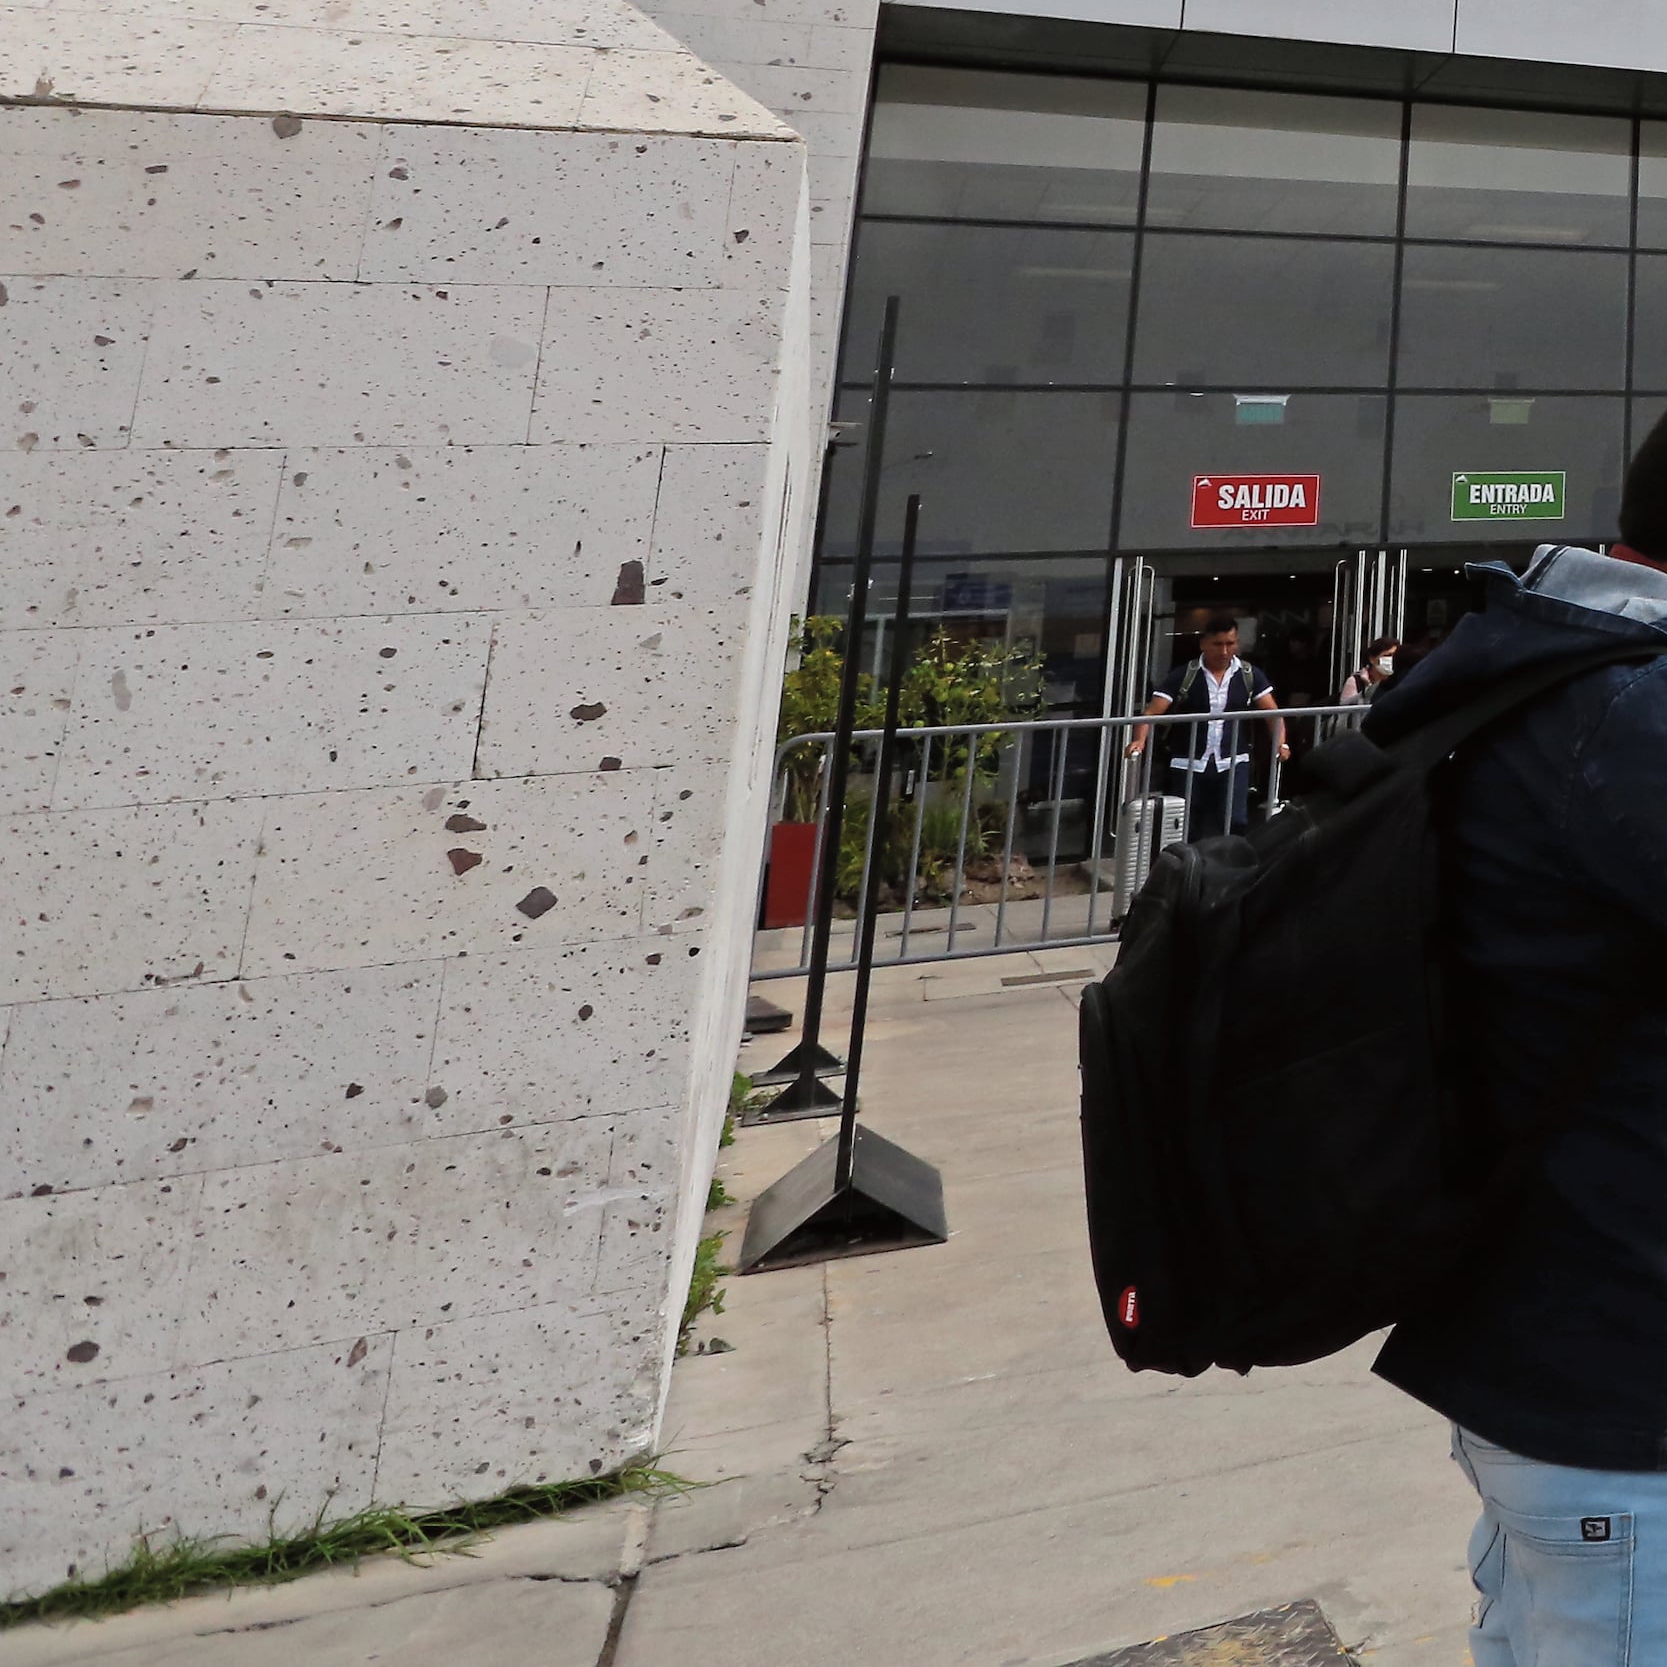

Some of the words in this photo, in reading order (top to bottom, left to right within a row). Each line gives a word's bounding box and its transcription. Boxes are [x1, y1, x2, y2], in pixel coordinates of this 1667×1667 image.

[1218, 483, 1306, 510] SALIDA
[1469, 483, 1555, 504] ENTRADA
[1241, 509, 1270, 521] EXIT
[1489, 503, 1528, 516] ENTRY
